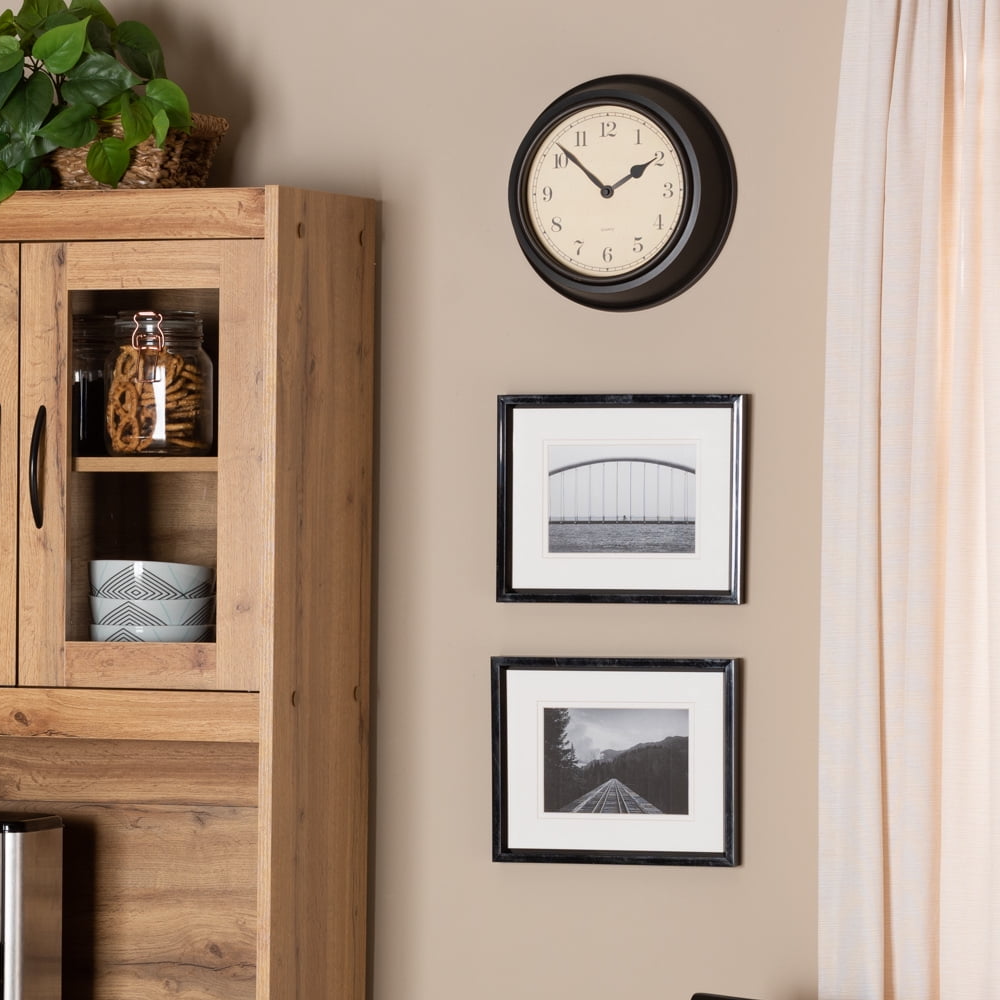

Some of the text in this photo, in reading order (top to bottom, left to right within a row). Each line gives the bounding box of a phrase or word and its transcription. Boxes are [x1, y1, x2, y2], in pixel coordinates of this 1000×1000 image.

[600, 122, 617, 137] 12
[634, 129, 643, 145] 1
[575, 131, 588, 147] 11
[553, 153, 568, 169] 10
[654, 151, 665, 167] 2
[542, 186, 553, 202] 9
[663, 182, 674, 198] 3
[550, 216, 562, 232] 8
[653, 214, 665, 230] 4
[574, 240, 584, 256] 7
[633, 237, 644, 253] 5
[602, 247, 613, 263] 6
